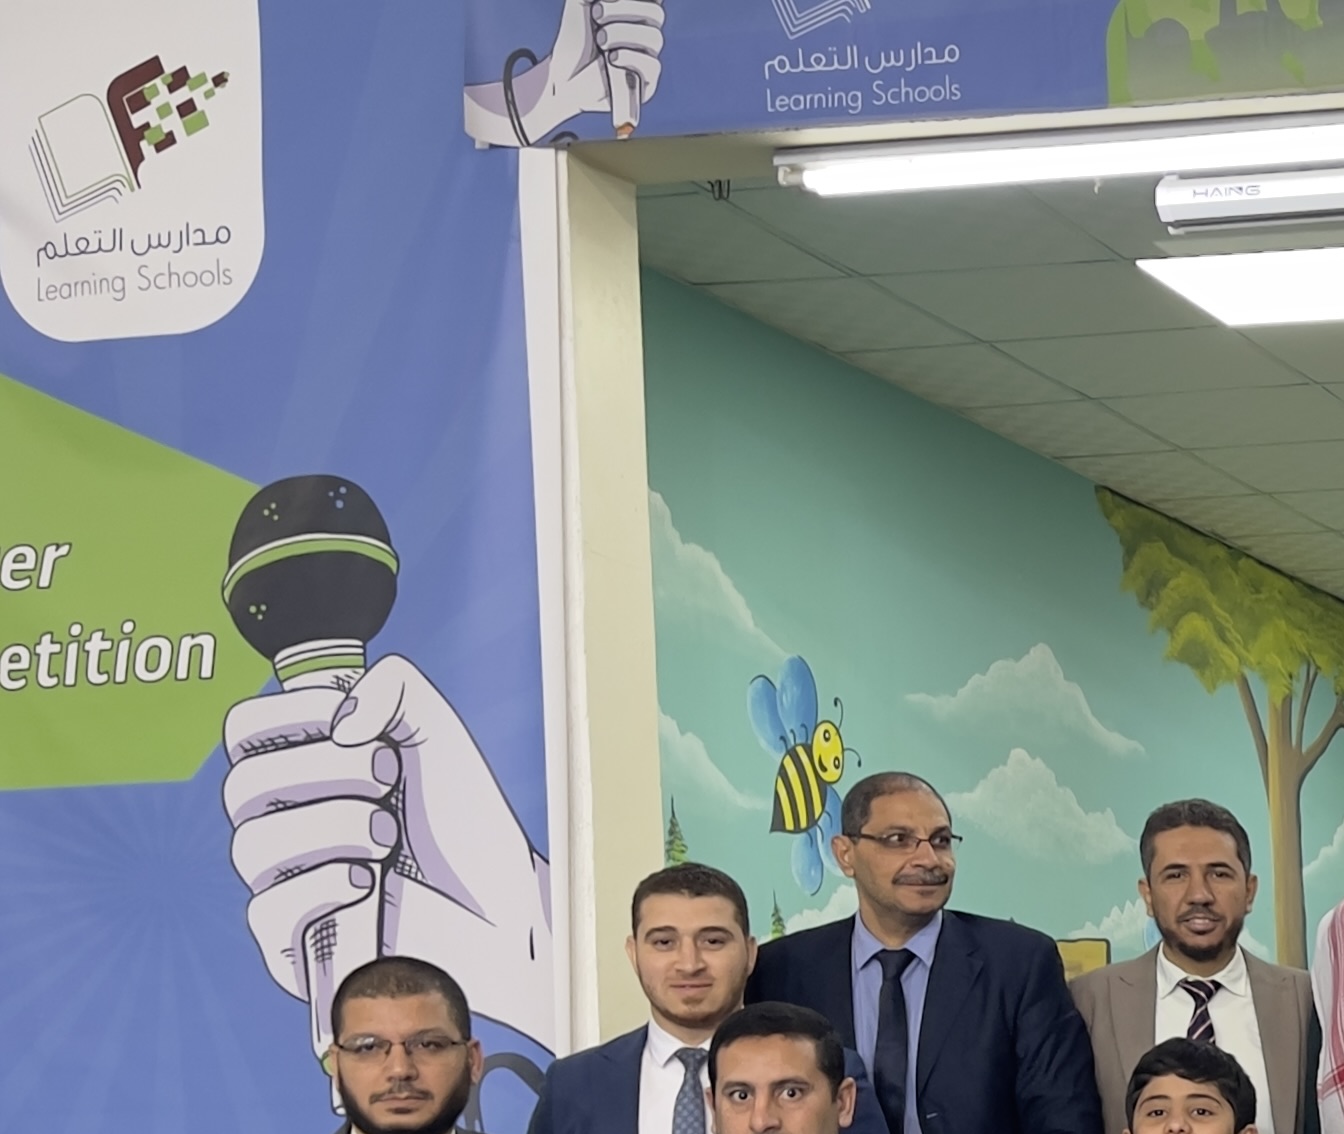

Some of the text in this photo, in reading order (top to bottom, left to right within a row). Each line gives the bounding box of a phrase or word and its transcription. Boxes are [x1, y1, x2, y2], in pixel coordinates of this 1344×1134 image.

[764, 41, 960, 80] مدارس التعلم
[766, 74, 962, 114] Learning Schools
[36, 222, 232, 267] مدارس التعلم
[37, 258, 233, 302] Learning Schools
[0, 542, 73, 591] er
[0, 619, 217, 691] etition
